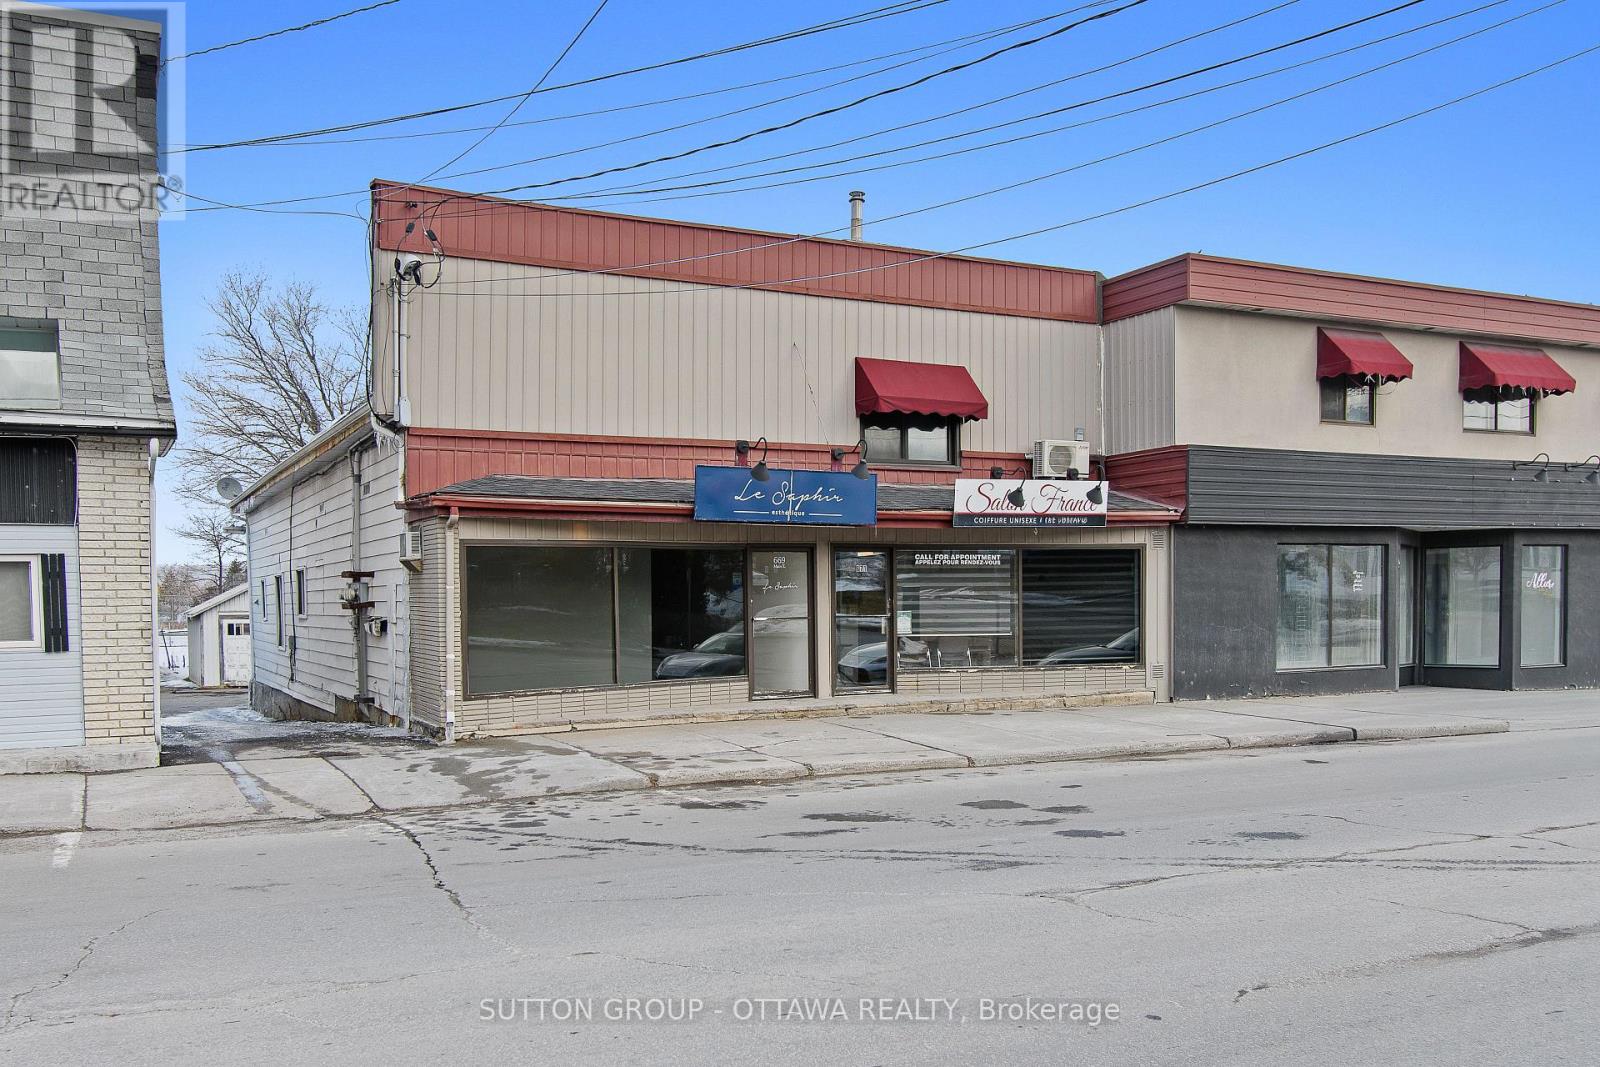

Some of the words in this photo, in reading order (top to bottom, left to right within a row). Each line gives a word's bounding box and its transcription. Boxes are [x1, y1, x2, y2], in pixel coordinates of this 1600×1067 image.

[734, 479, 765, 501] Le
[772, 481, 843, 511] Saphir
[973, 516, 1006, 524] COIFFURE
